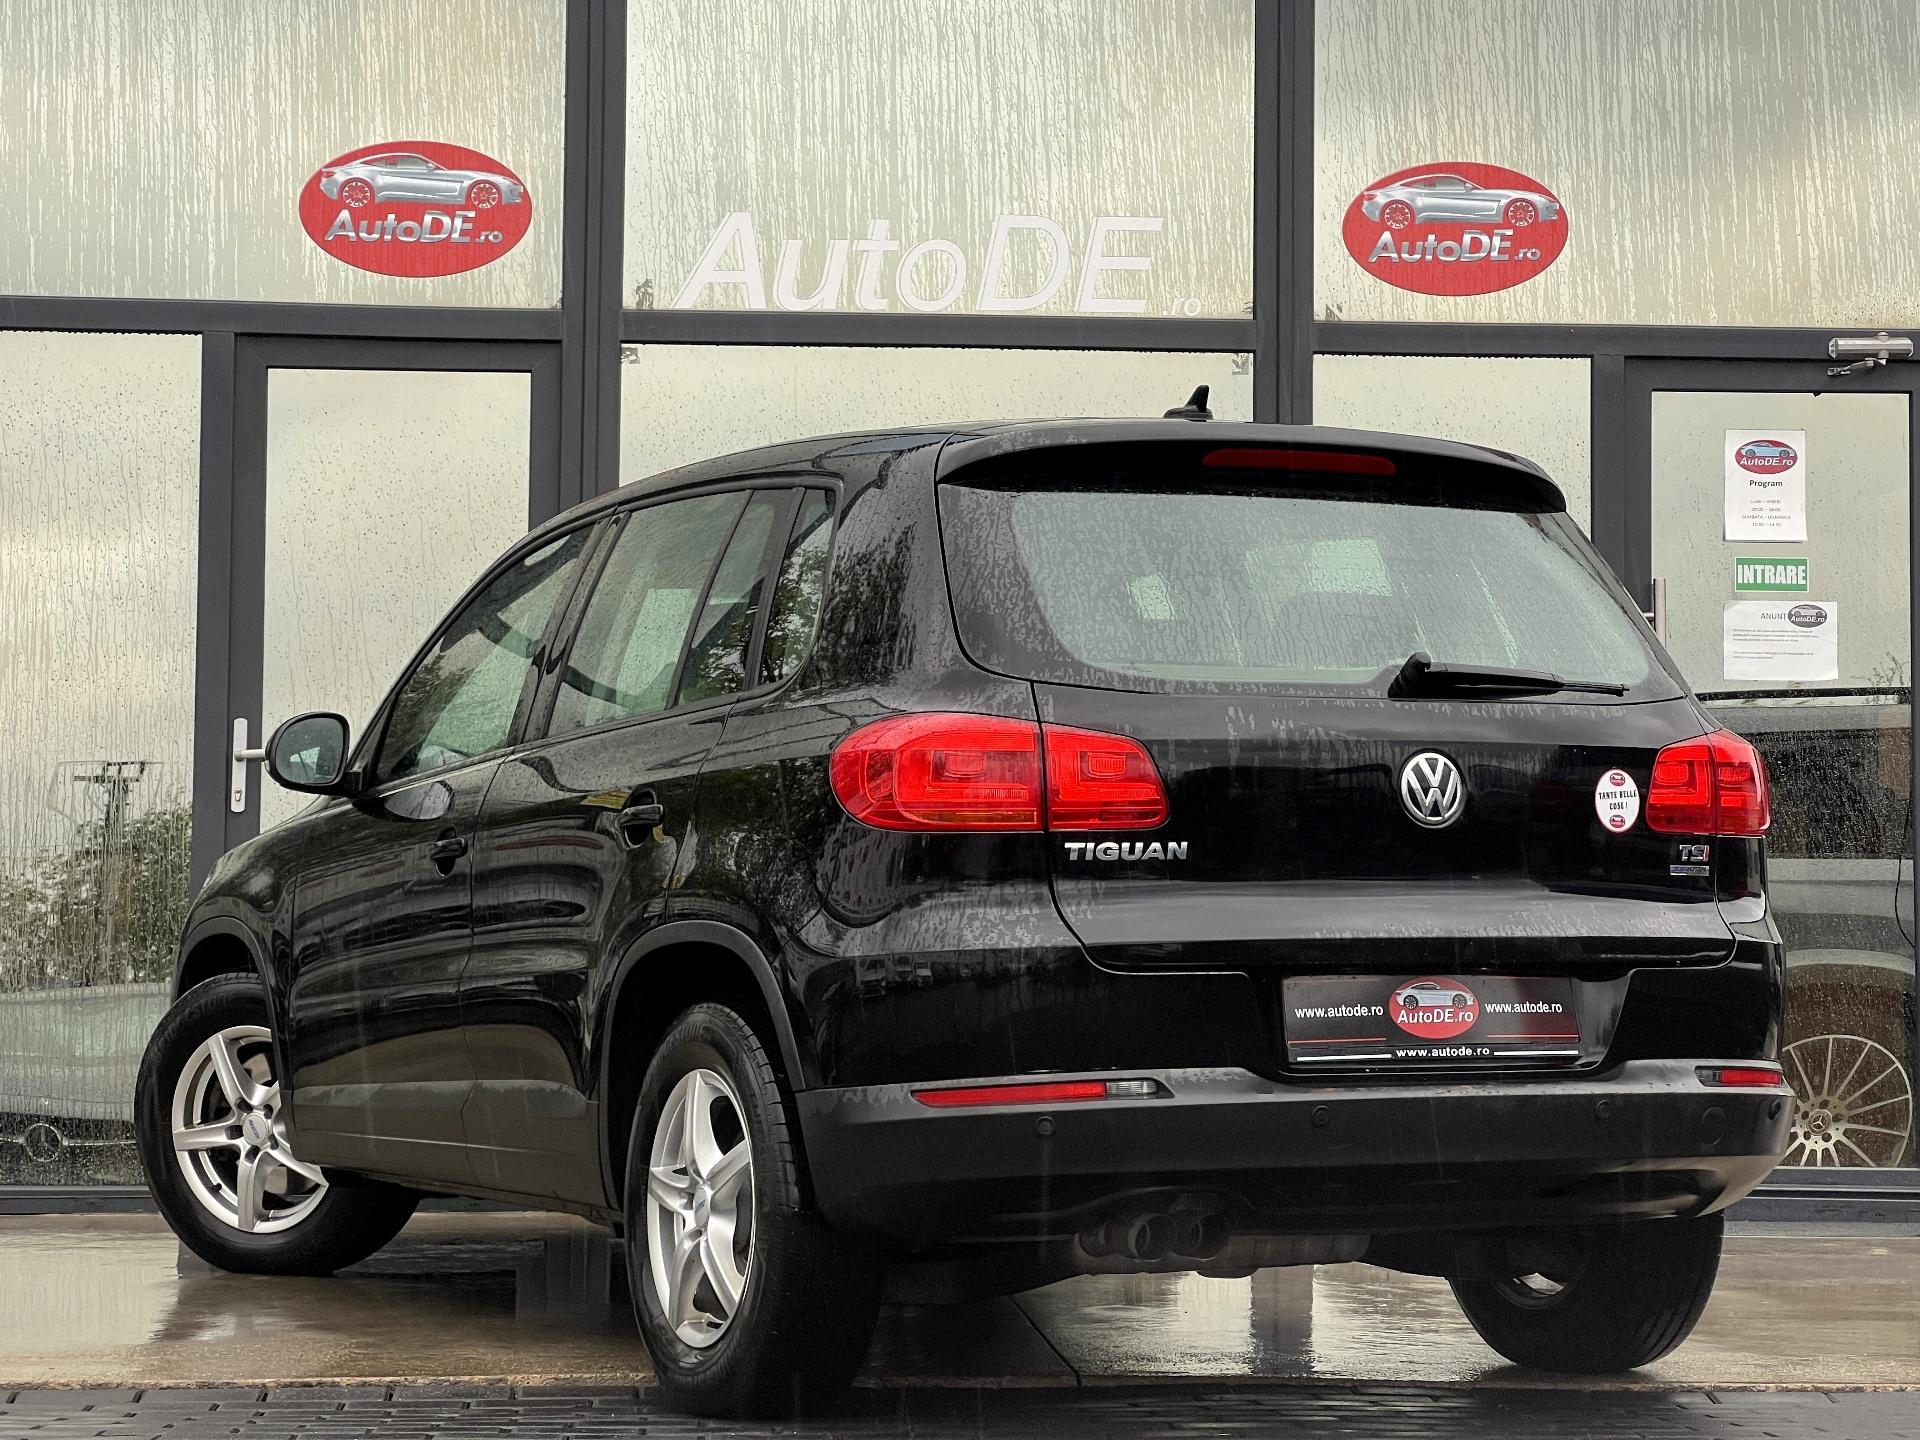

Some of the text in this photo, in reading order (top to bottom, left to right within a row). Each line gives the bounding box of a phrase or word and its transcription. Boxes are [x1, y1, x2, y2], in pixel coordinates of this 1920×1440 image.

[1749, 480, 1783, 488] Program
[1737, 564, 1806, 585] INTRARE
[1598, 789, 1637, 800] TANTE BELLE
[1064, 841, 1189, 861] TIGUAN
[1679, 844, 1710, 862] TSI
[1294, 1004, 1384, 1018] www.autode.ro
[1484, 1000, 1563, 1013] www.autode.ro
[1397, 1009, 1475, 1024] AutoDE.ro
[1396, 1046, 1491, 1057] www.autode.ro
